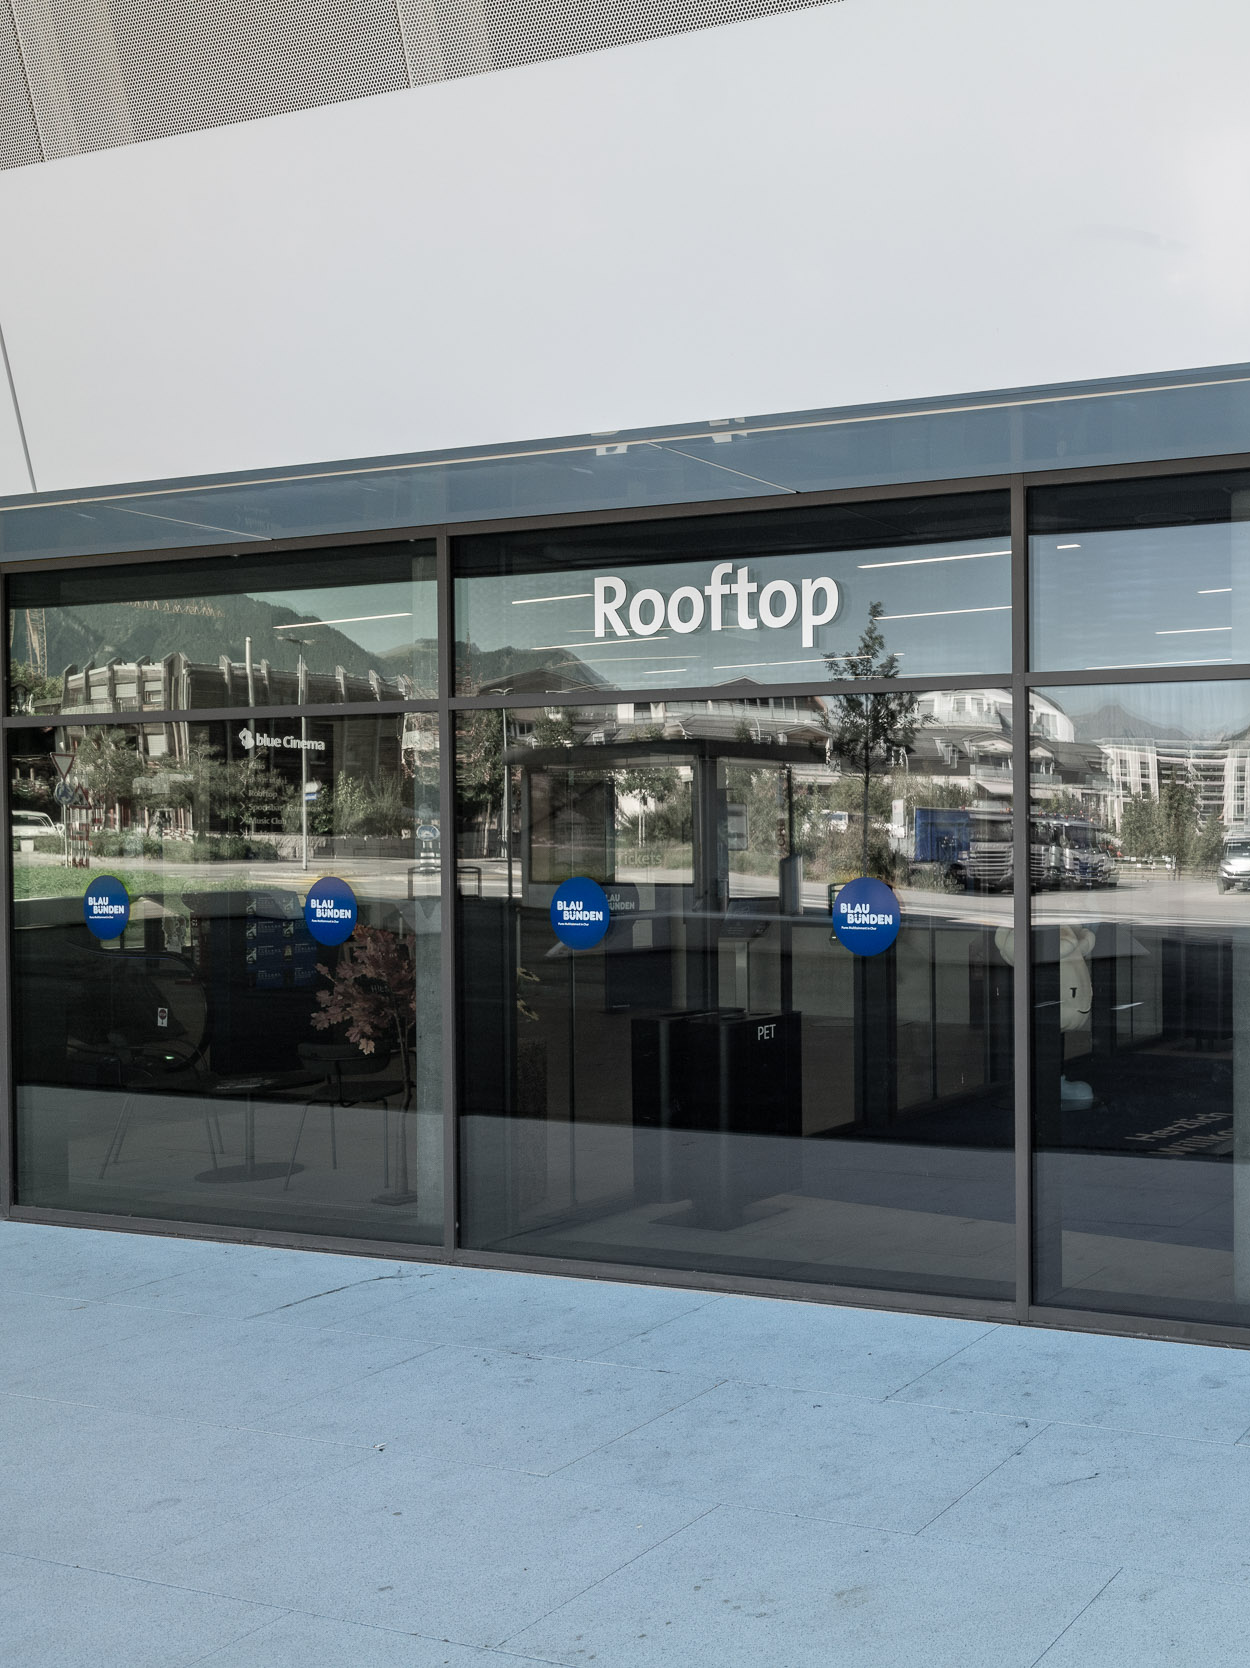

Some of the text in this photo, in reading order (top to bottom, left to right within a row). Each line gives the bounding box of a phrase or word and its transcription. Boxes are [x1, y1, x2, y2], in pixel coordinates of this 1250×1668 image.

[594, 562, 839, 648] Rooftop
[256, 733, 326, 751] blue Cinema
[249, 789, 278, 799] Rooftop
[249, 816, 269, 825] Music
[88, 896, 109, 906] BLAU
[606, 893, 620, 901] LAU
[310, 898, 334, 909] BLAU
[556, 901, 583, 911] BLAU
[610, 901, 635, 910] ÜNDEN
[840, 902, 870, 914] BLAU
[93, 905, 125, 915] BÜNDEN
[316, 908, 352, 919] BÜNDEN
[563, 910, 603, 921] BÜNDEN
[847, 913, 893, 925] BÜNDEN
[757, 1024, 777, 1041] PET
[1124, 1112, 1234, 1142] Herzlich
[1147, 1129, 1234, 1156] Willko
